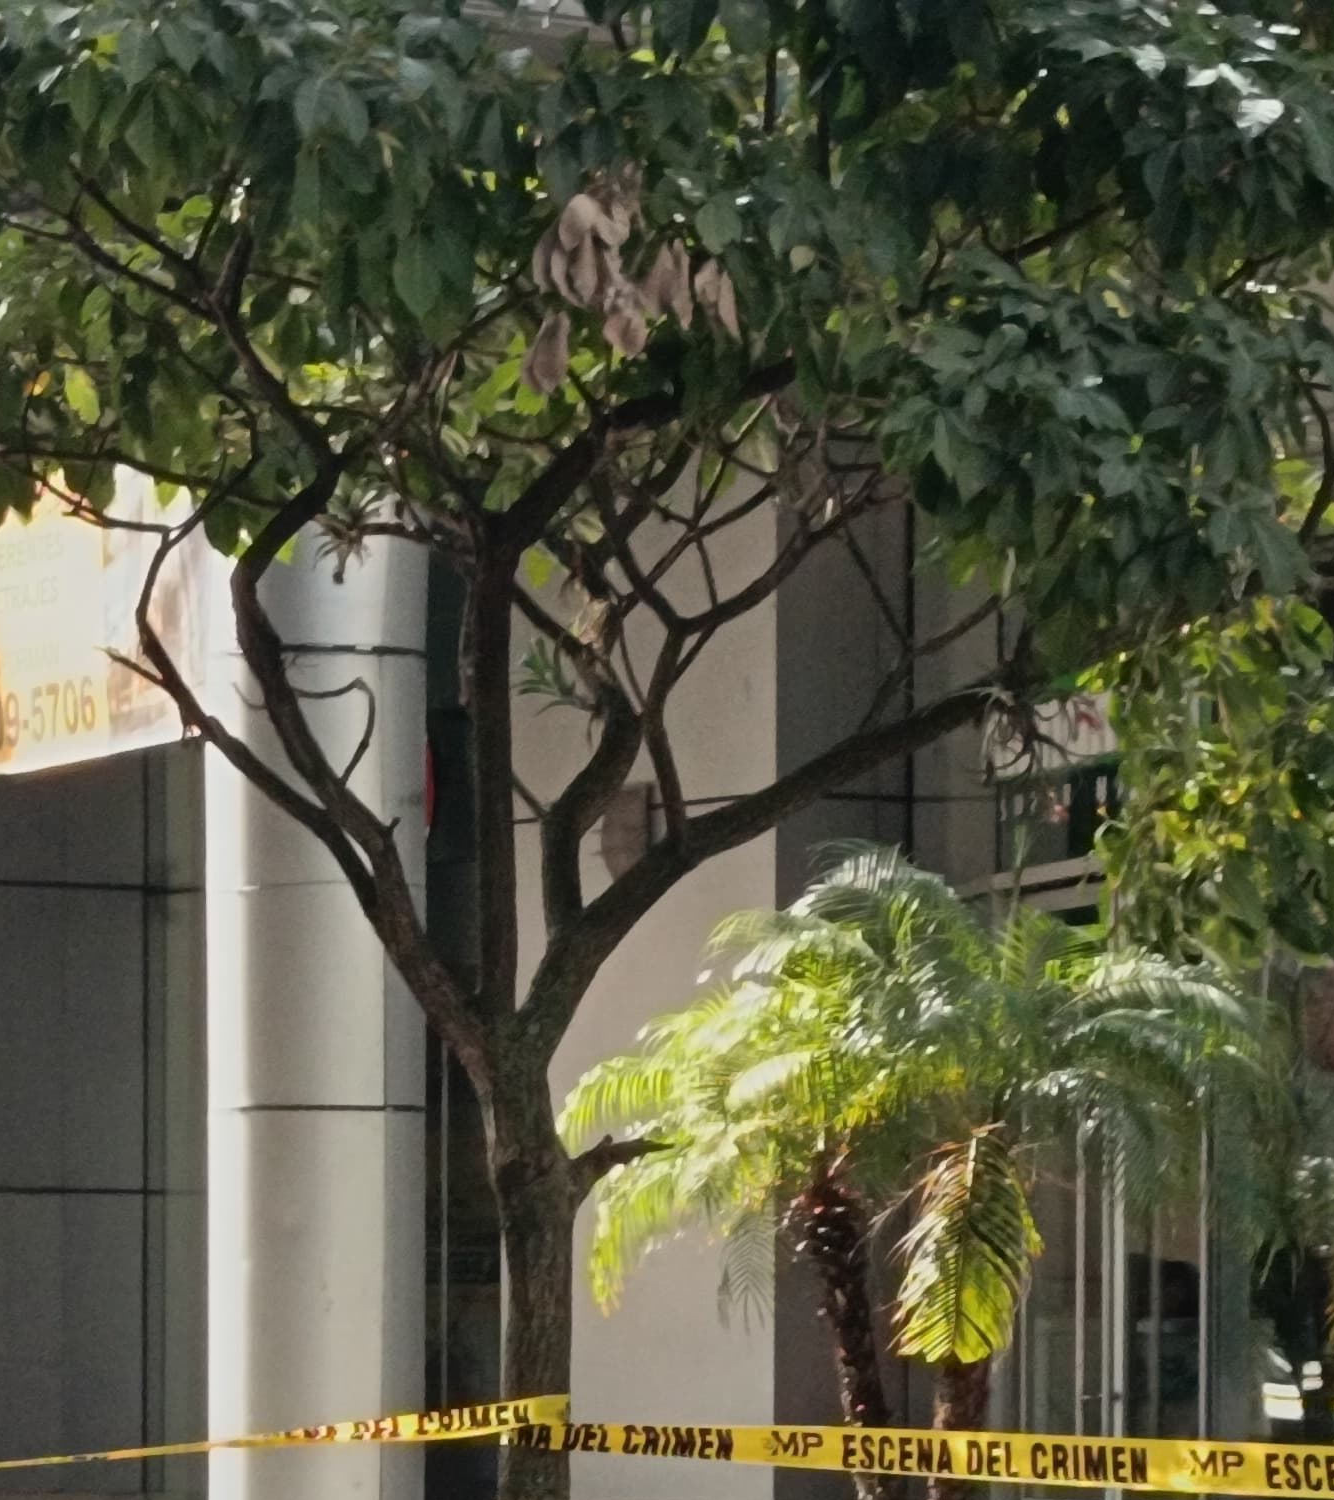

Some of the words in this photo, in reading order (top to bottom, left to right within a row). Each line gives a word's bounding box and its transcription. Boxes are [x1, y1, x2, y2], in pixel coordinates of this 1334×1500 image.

[562, 1423, 611, 1452] DEL
[621, 1424, 734, 1461] CRIMEN
[770, 1430, 824, 1457] MP
[842, 1434, 954, 1475] ESCENA
[966, 1440, 1020, 1478] DEL
[1030, 1443, 1148, 1483] CRIMEN
[1188, 1450, 1245, 1478] MP
